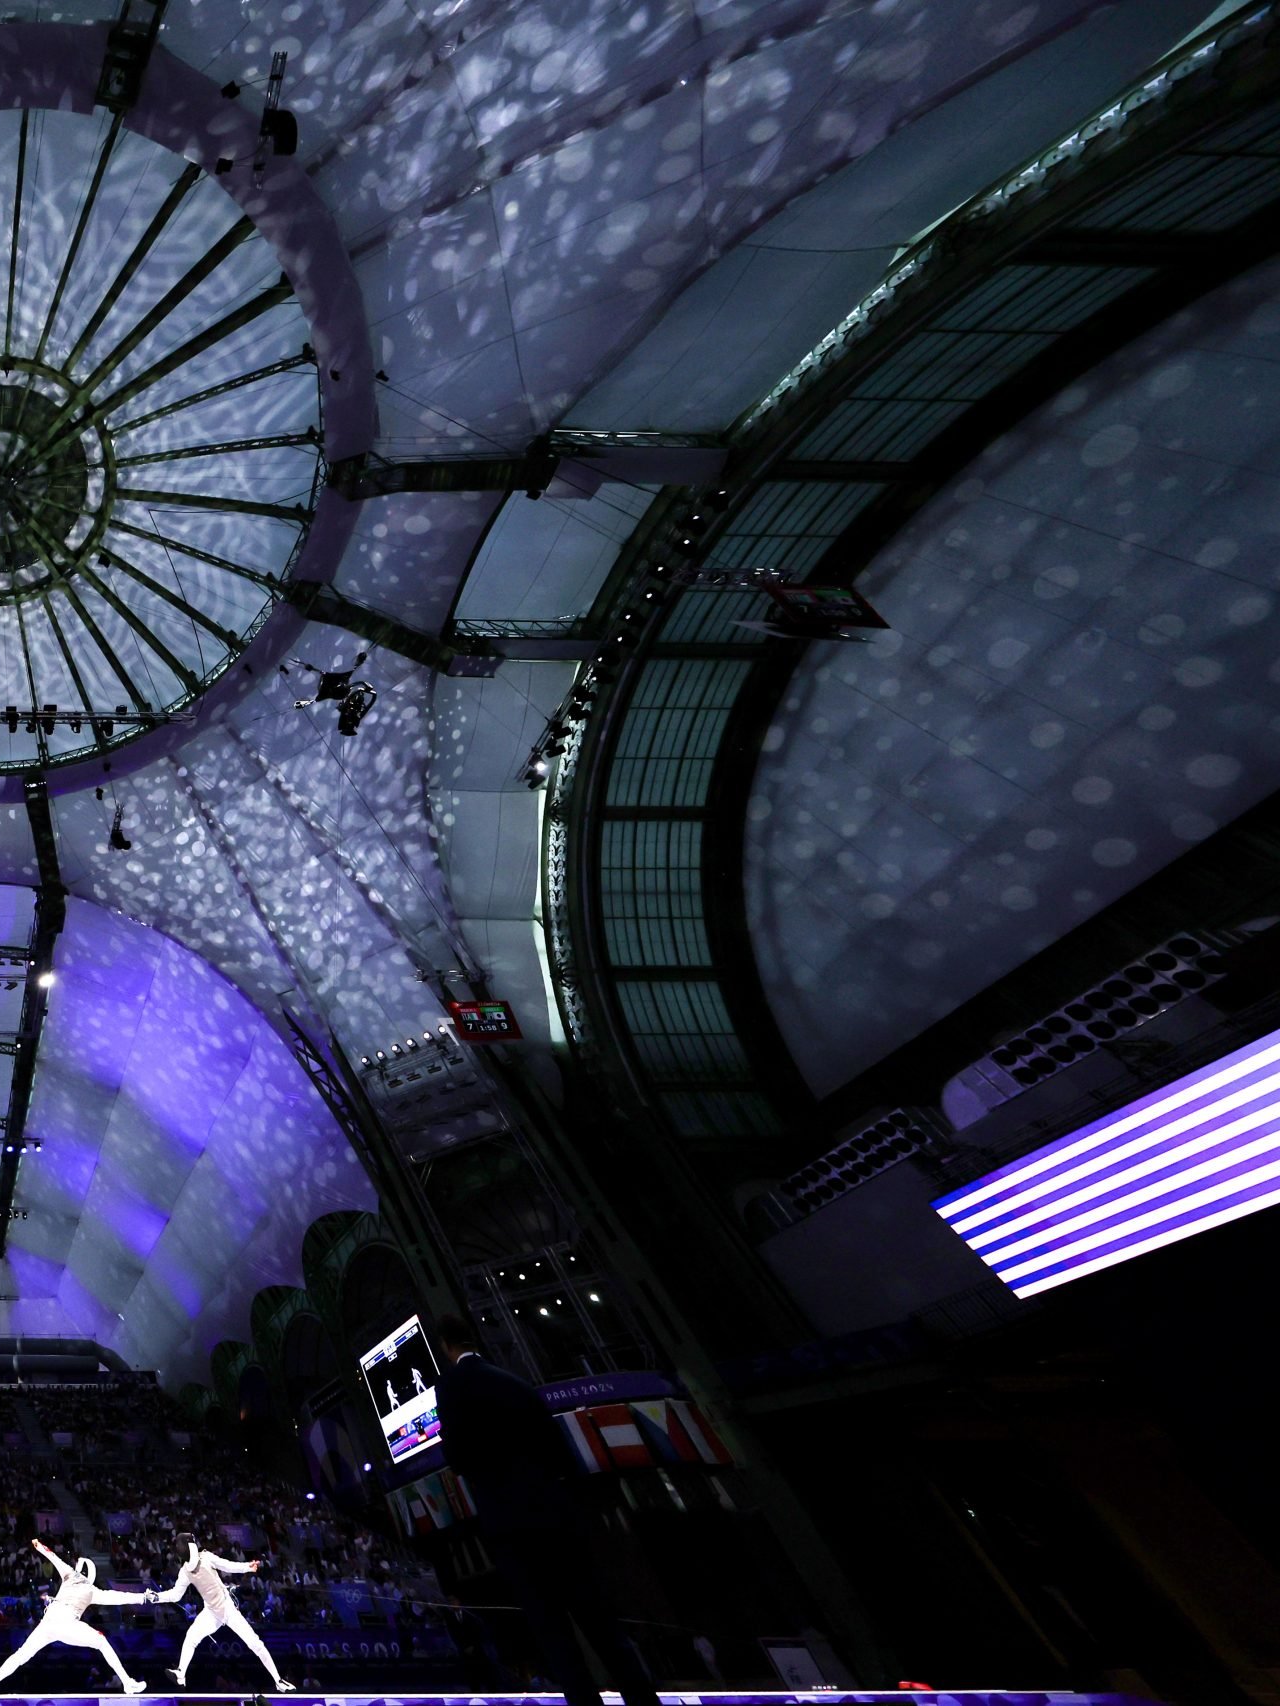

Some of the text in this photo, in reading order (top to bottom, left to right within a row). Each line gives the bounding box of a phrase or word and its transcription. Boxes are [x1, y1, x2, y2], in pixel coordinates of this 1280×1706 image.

[501, 1022, 508, 1030] 9
[545, 1383, 615, 1401] PARIS 2024
[294, 1642, 353, 1659] ARS
